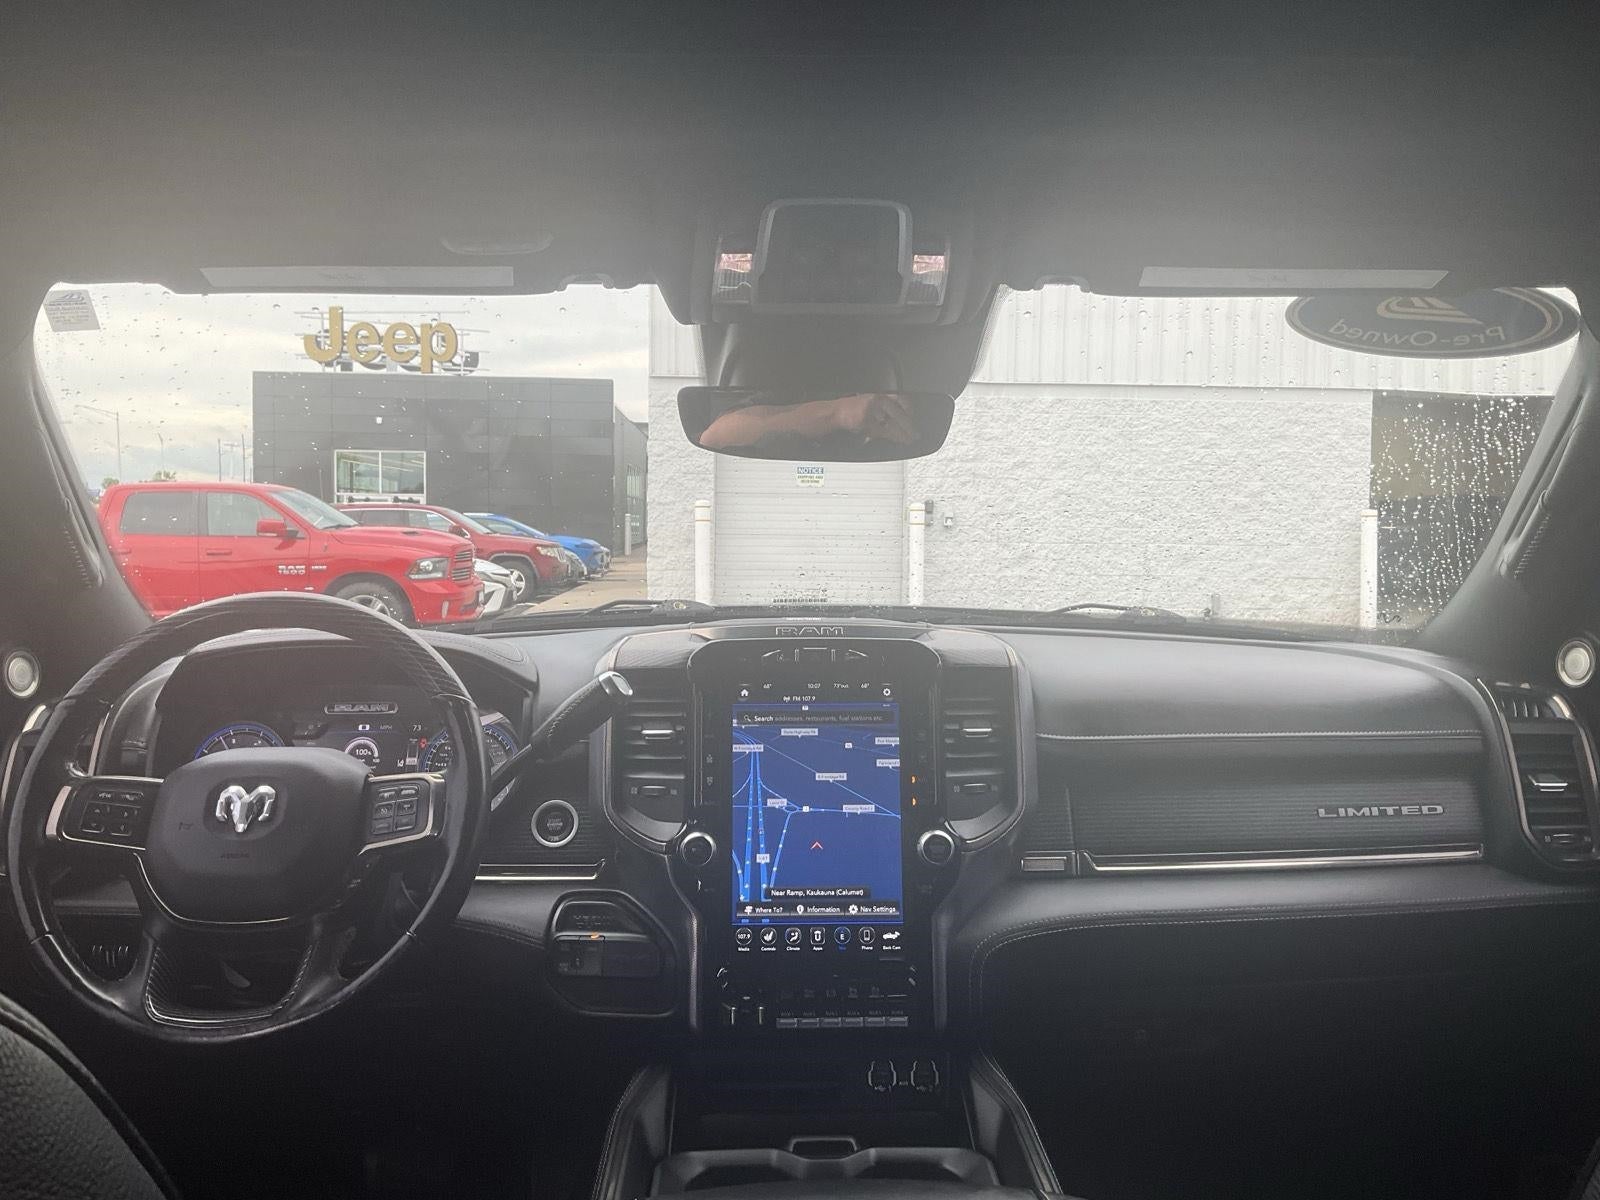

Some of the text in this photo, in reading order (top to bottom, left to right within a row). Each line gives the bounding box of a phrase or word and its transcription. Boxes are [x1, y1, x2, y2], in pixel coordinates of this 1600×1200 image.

[303, 306, 458, 374] Jeep
[797, 466, 824, 474] NOTICE
[775, 626, 844, 636] RAM
[850, 714, 871, 722] stations
[1317, 805, 1444, 818] LIMITED
[786, 888, 805, 898] Ramp,
[806, 888, 834, 896] Kaukauna
[836, 887, 864, 897] (Calumet)
[755, 906, 769, 914] Where
[874, 905, 896, 915] Settings
